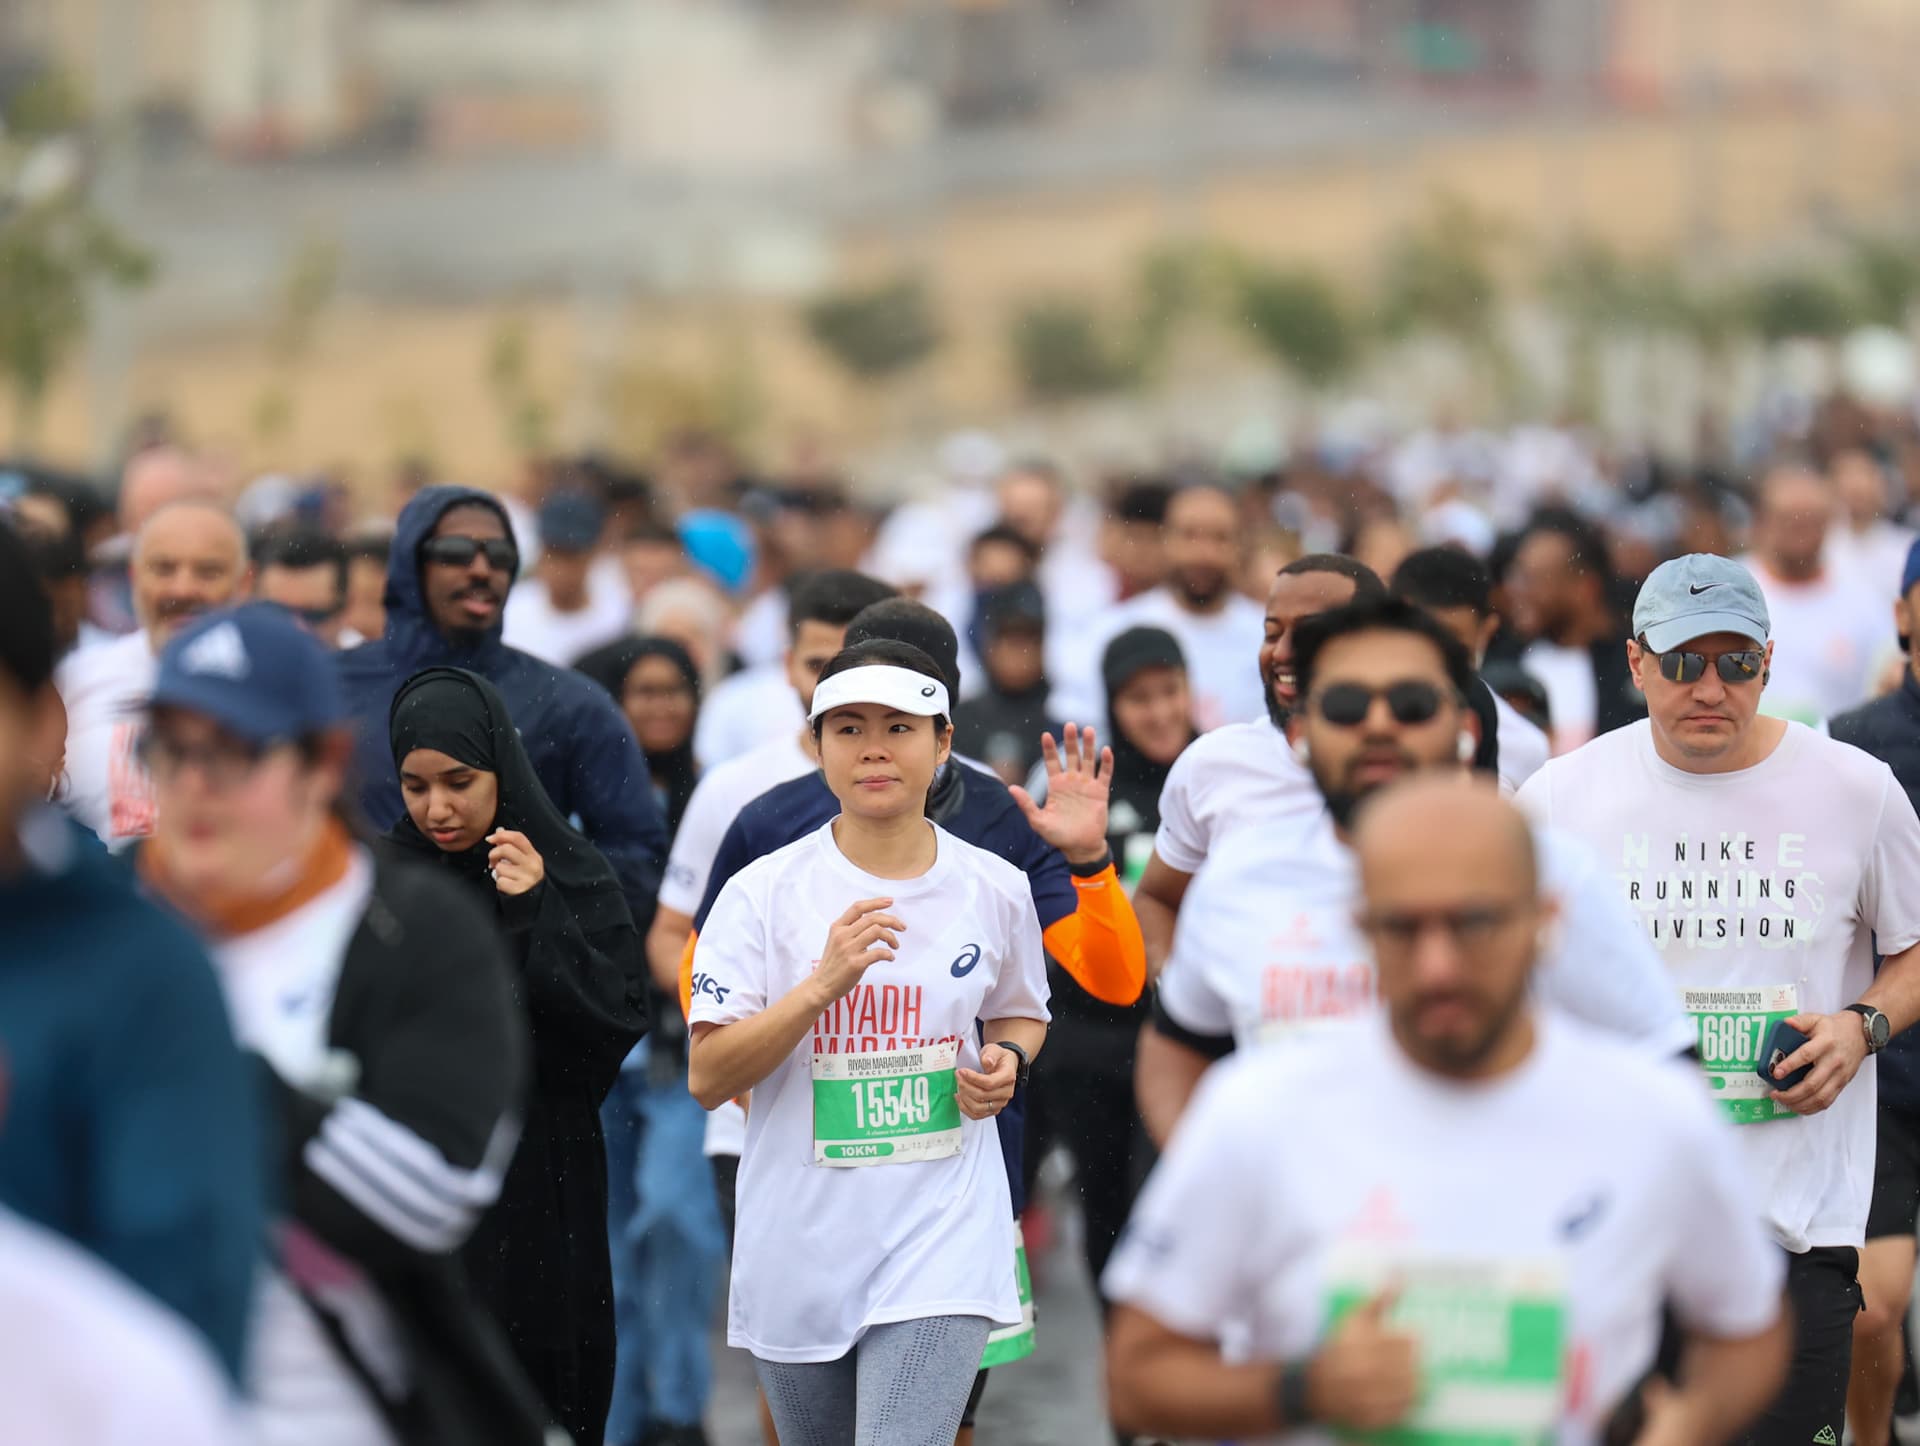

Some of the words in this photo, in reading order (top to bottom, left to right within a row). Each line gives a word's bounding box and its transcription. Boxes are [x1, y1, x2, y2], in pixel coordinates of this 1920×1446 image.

[1675, 841, 1755, 861] NIKE
[1630, 879, 1796, 900] RUNNING
[1636, 917, 1795, 939] IVISION
[690, 972, 731, 1005] SICS
[1685, 991, 1709, 1005] RIYADH
[1710, 991, 1746, 1005] MARATHON
[847, 1057, 872, 1072] RIYADH
[872, 1055, 909, 1070] MARATHON
[909, 1053, 923, 1067] 2024
[851, 1076, 930, 1129] 15549
[840, 1145, 877, 1157] 10KM
